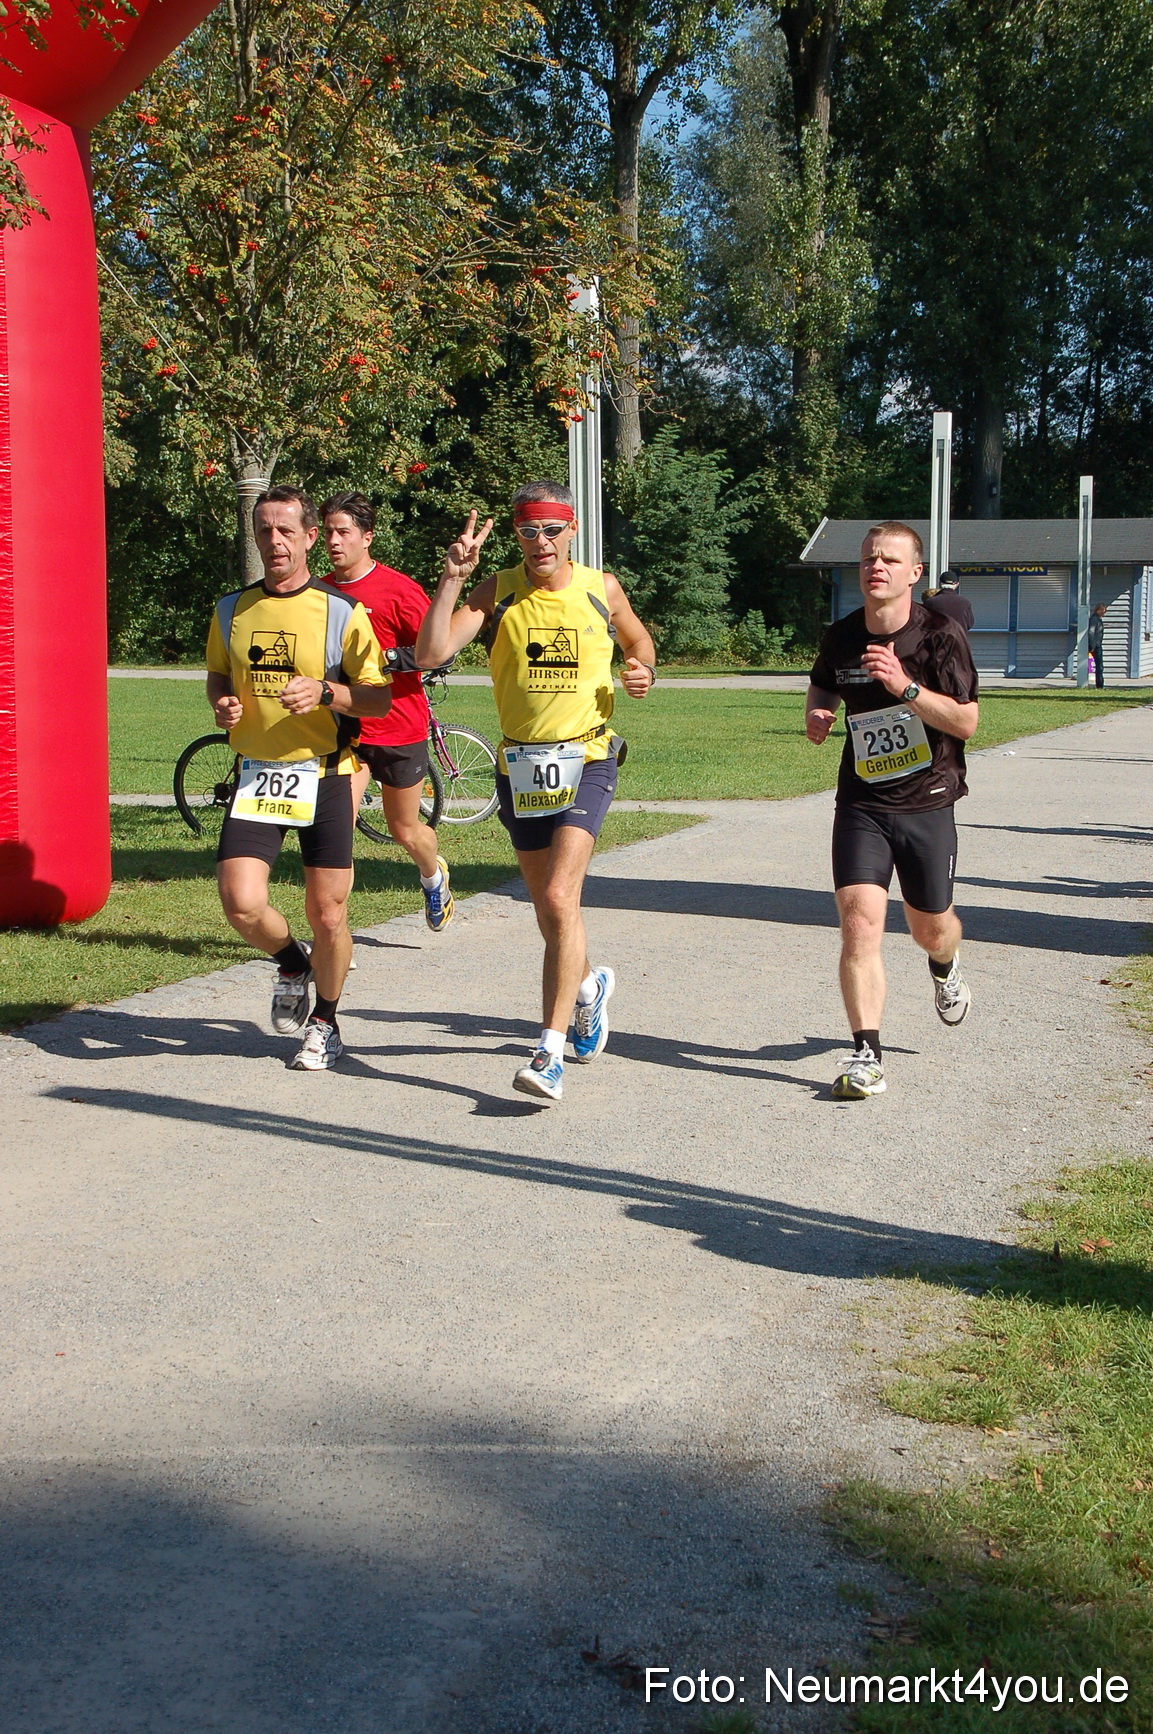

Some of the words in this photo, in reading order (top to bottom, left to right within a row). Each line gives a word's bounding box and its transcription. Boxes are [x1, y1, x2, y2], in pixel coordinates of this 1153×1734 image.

[529, 669, 578, 679] HIRSCH
[863, 724, 909, 757] 233
[865, 748, 918, 774] Gerhard
[254, 771, 300, 799] 262
[532, 763, 560, 790] 40
[256, 799, 293, 815] Franz
[519, 788, 574, 808] Alexander
